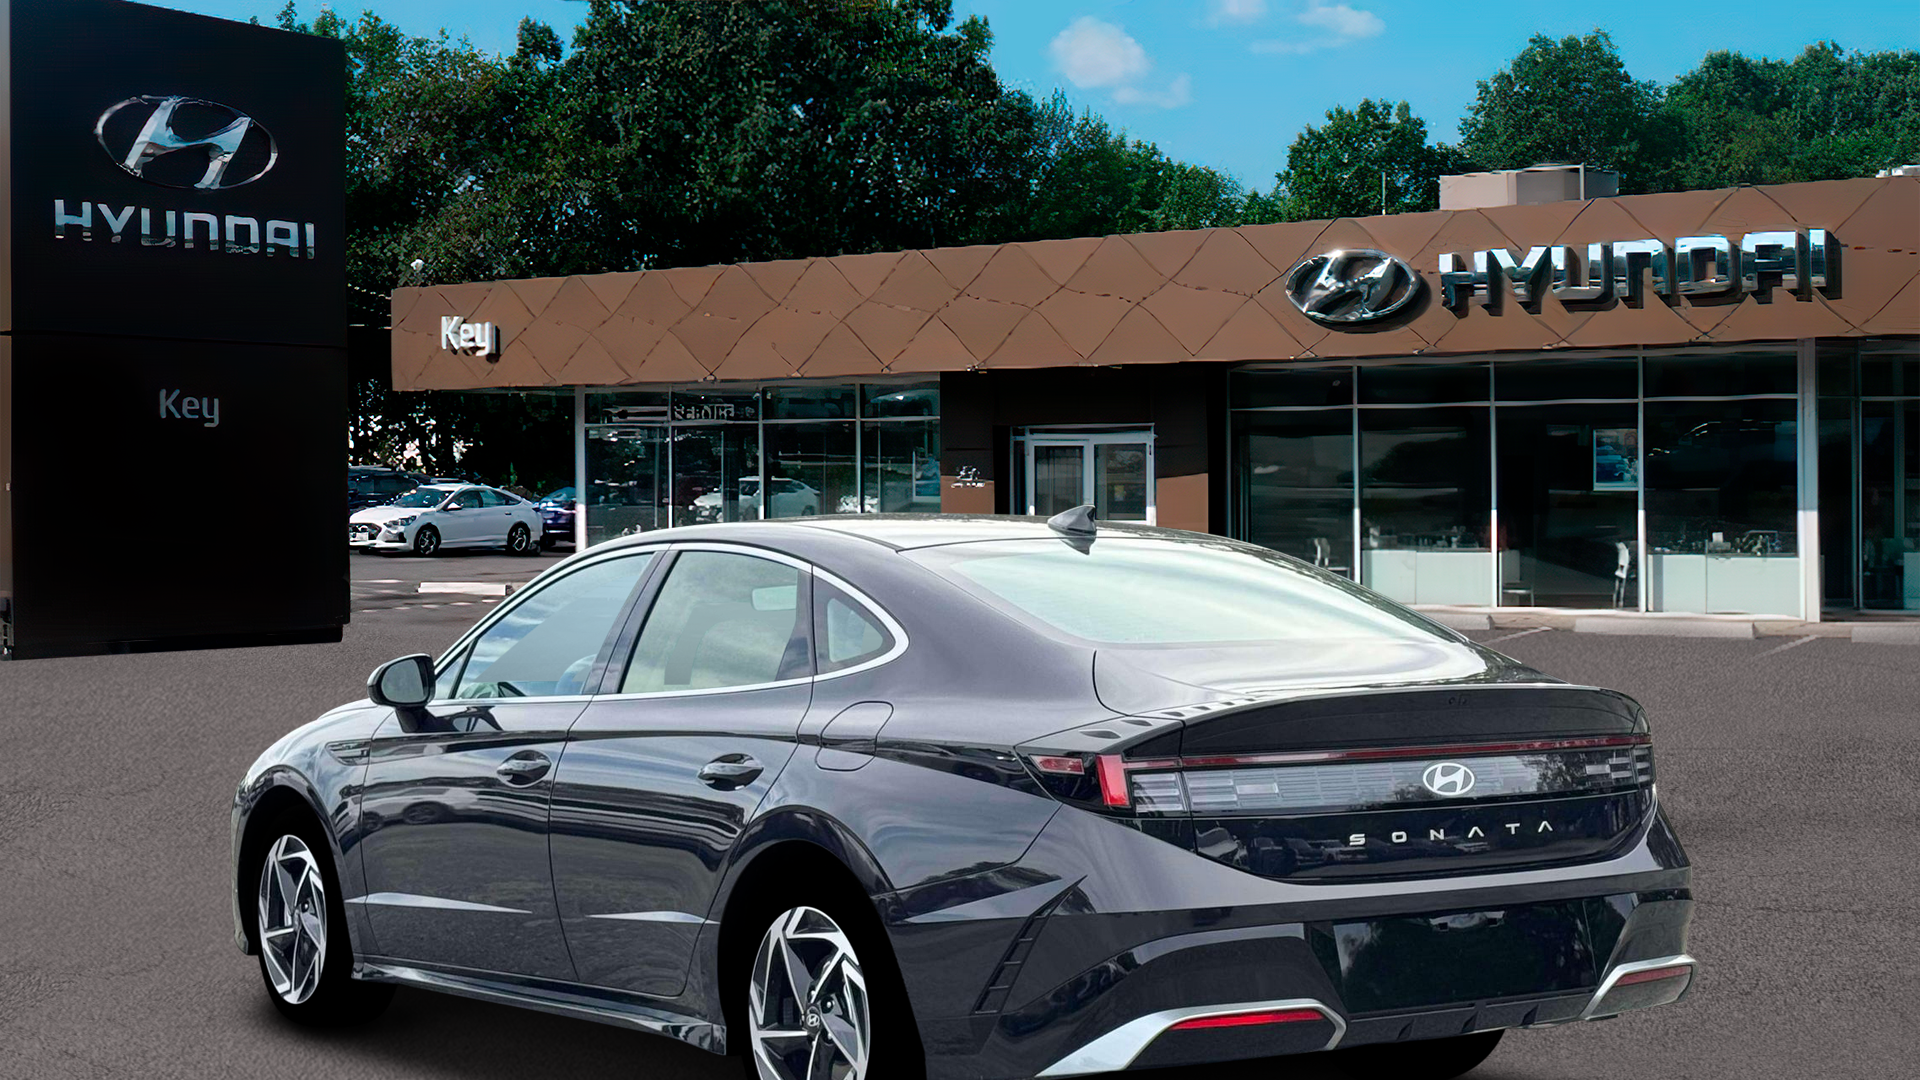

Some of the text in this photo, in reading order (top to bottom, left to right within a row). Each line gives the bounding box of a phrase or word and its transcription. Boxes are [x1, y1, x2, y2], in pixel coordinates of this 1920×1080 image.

[54, 199, 316, 260] HYUNDAI
[1438, 228, 1841, 314] HYUNDAI
[441, 315, 495, 357] Key
[159, 388, 220, 428] Key
[1349, 820, 1553, 846] SONATA
